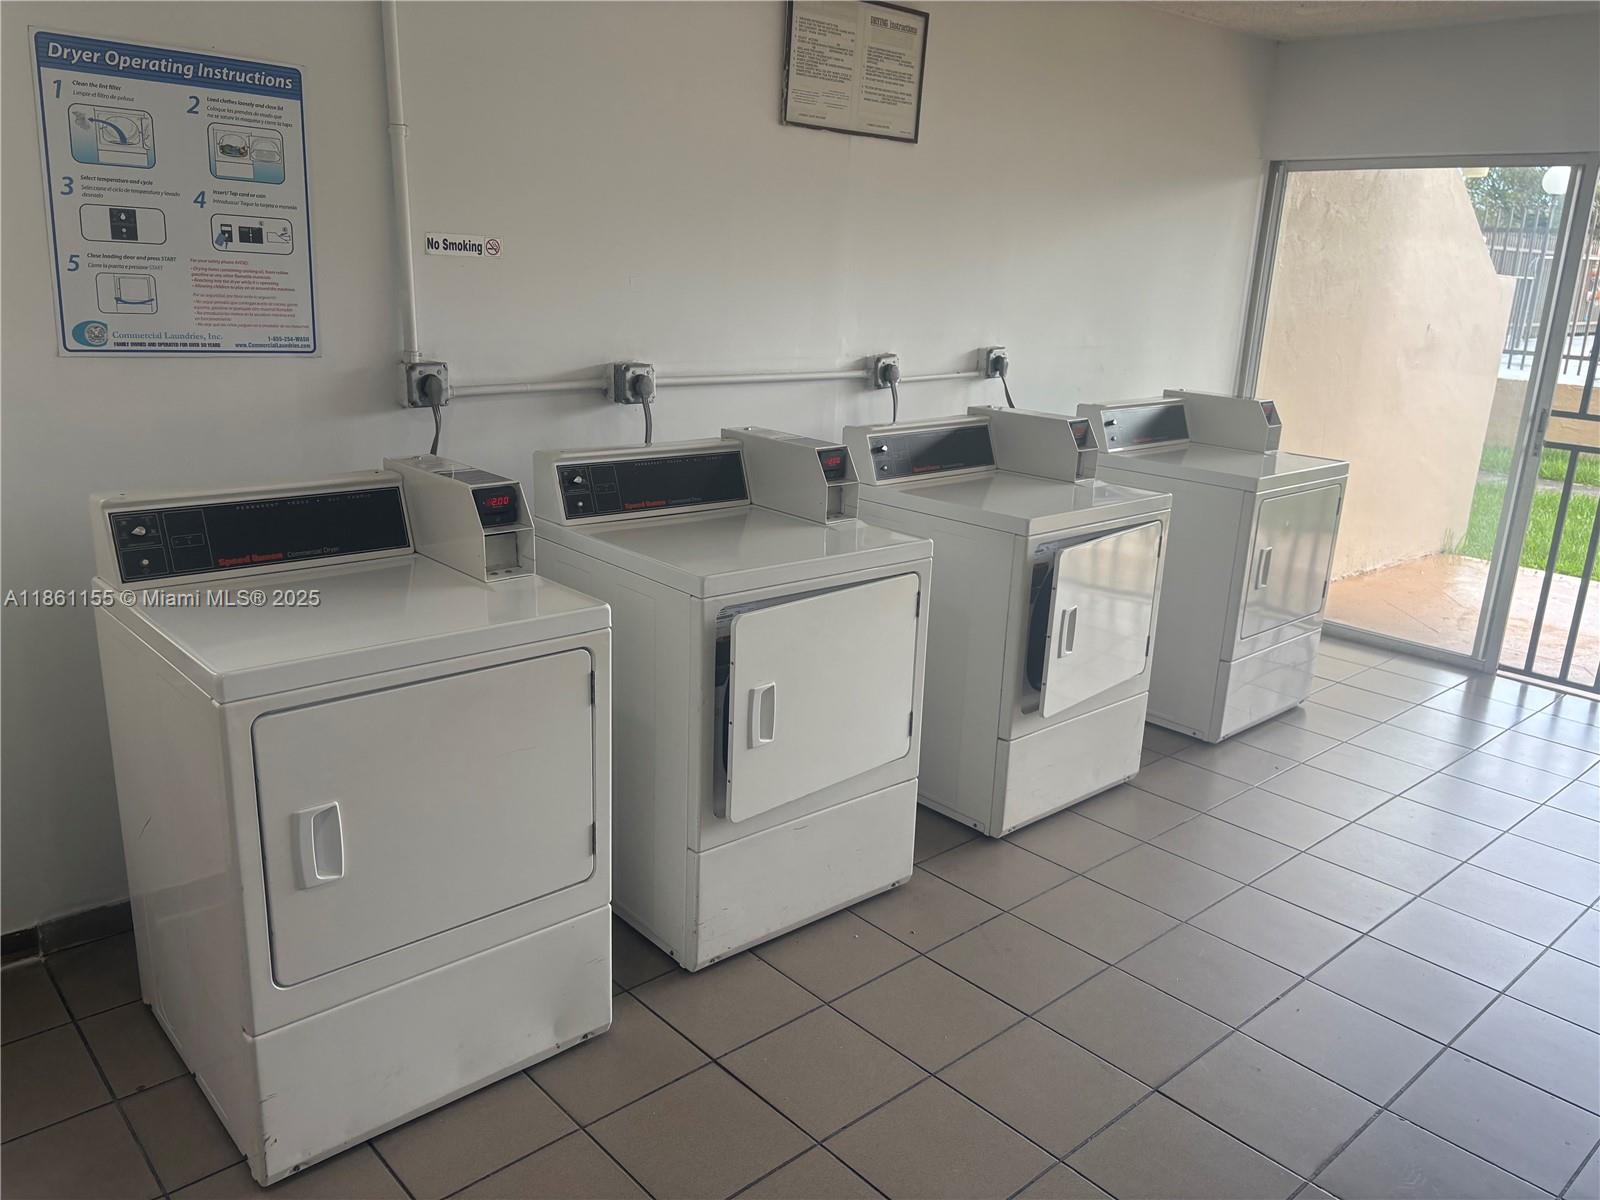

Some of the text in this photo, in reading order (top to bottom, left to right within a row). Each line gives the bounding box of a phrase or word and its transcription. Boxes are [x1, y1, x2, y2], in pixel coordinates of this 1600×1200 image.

[48, 42, 292, 89] Dryer Operating Instructions
[53, 80, 62, 98] 1
[186, 96, 200, 114] 2
[60, 176, 74, 196] 3
[80, 174, 97, 182] Select
[192, 190, 206, 208] 4
[426, 237, 482, 255] No Smoking
[67, 254, 80, 272] 5
[112, 330, 224, 341] Commercial Laundries, Inc.
[218, 555, 250, 567] Speed
